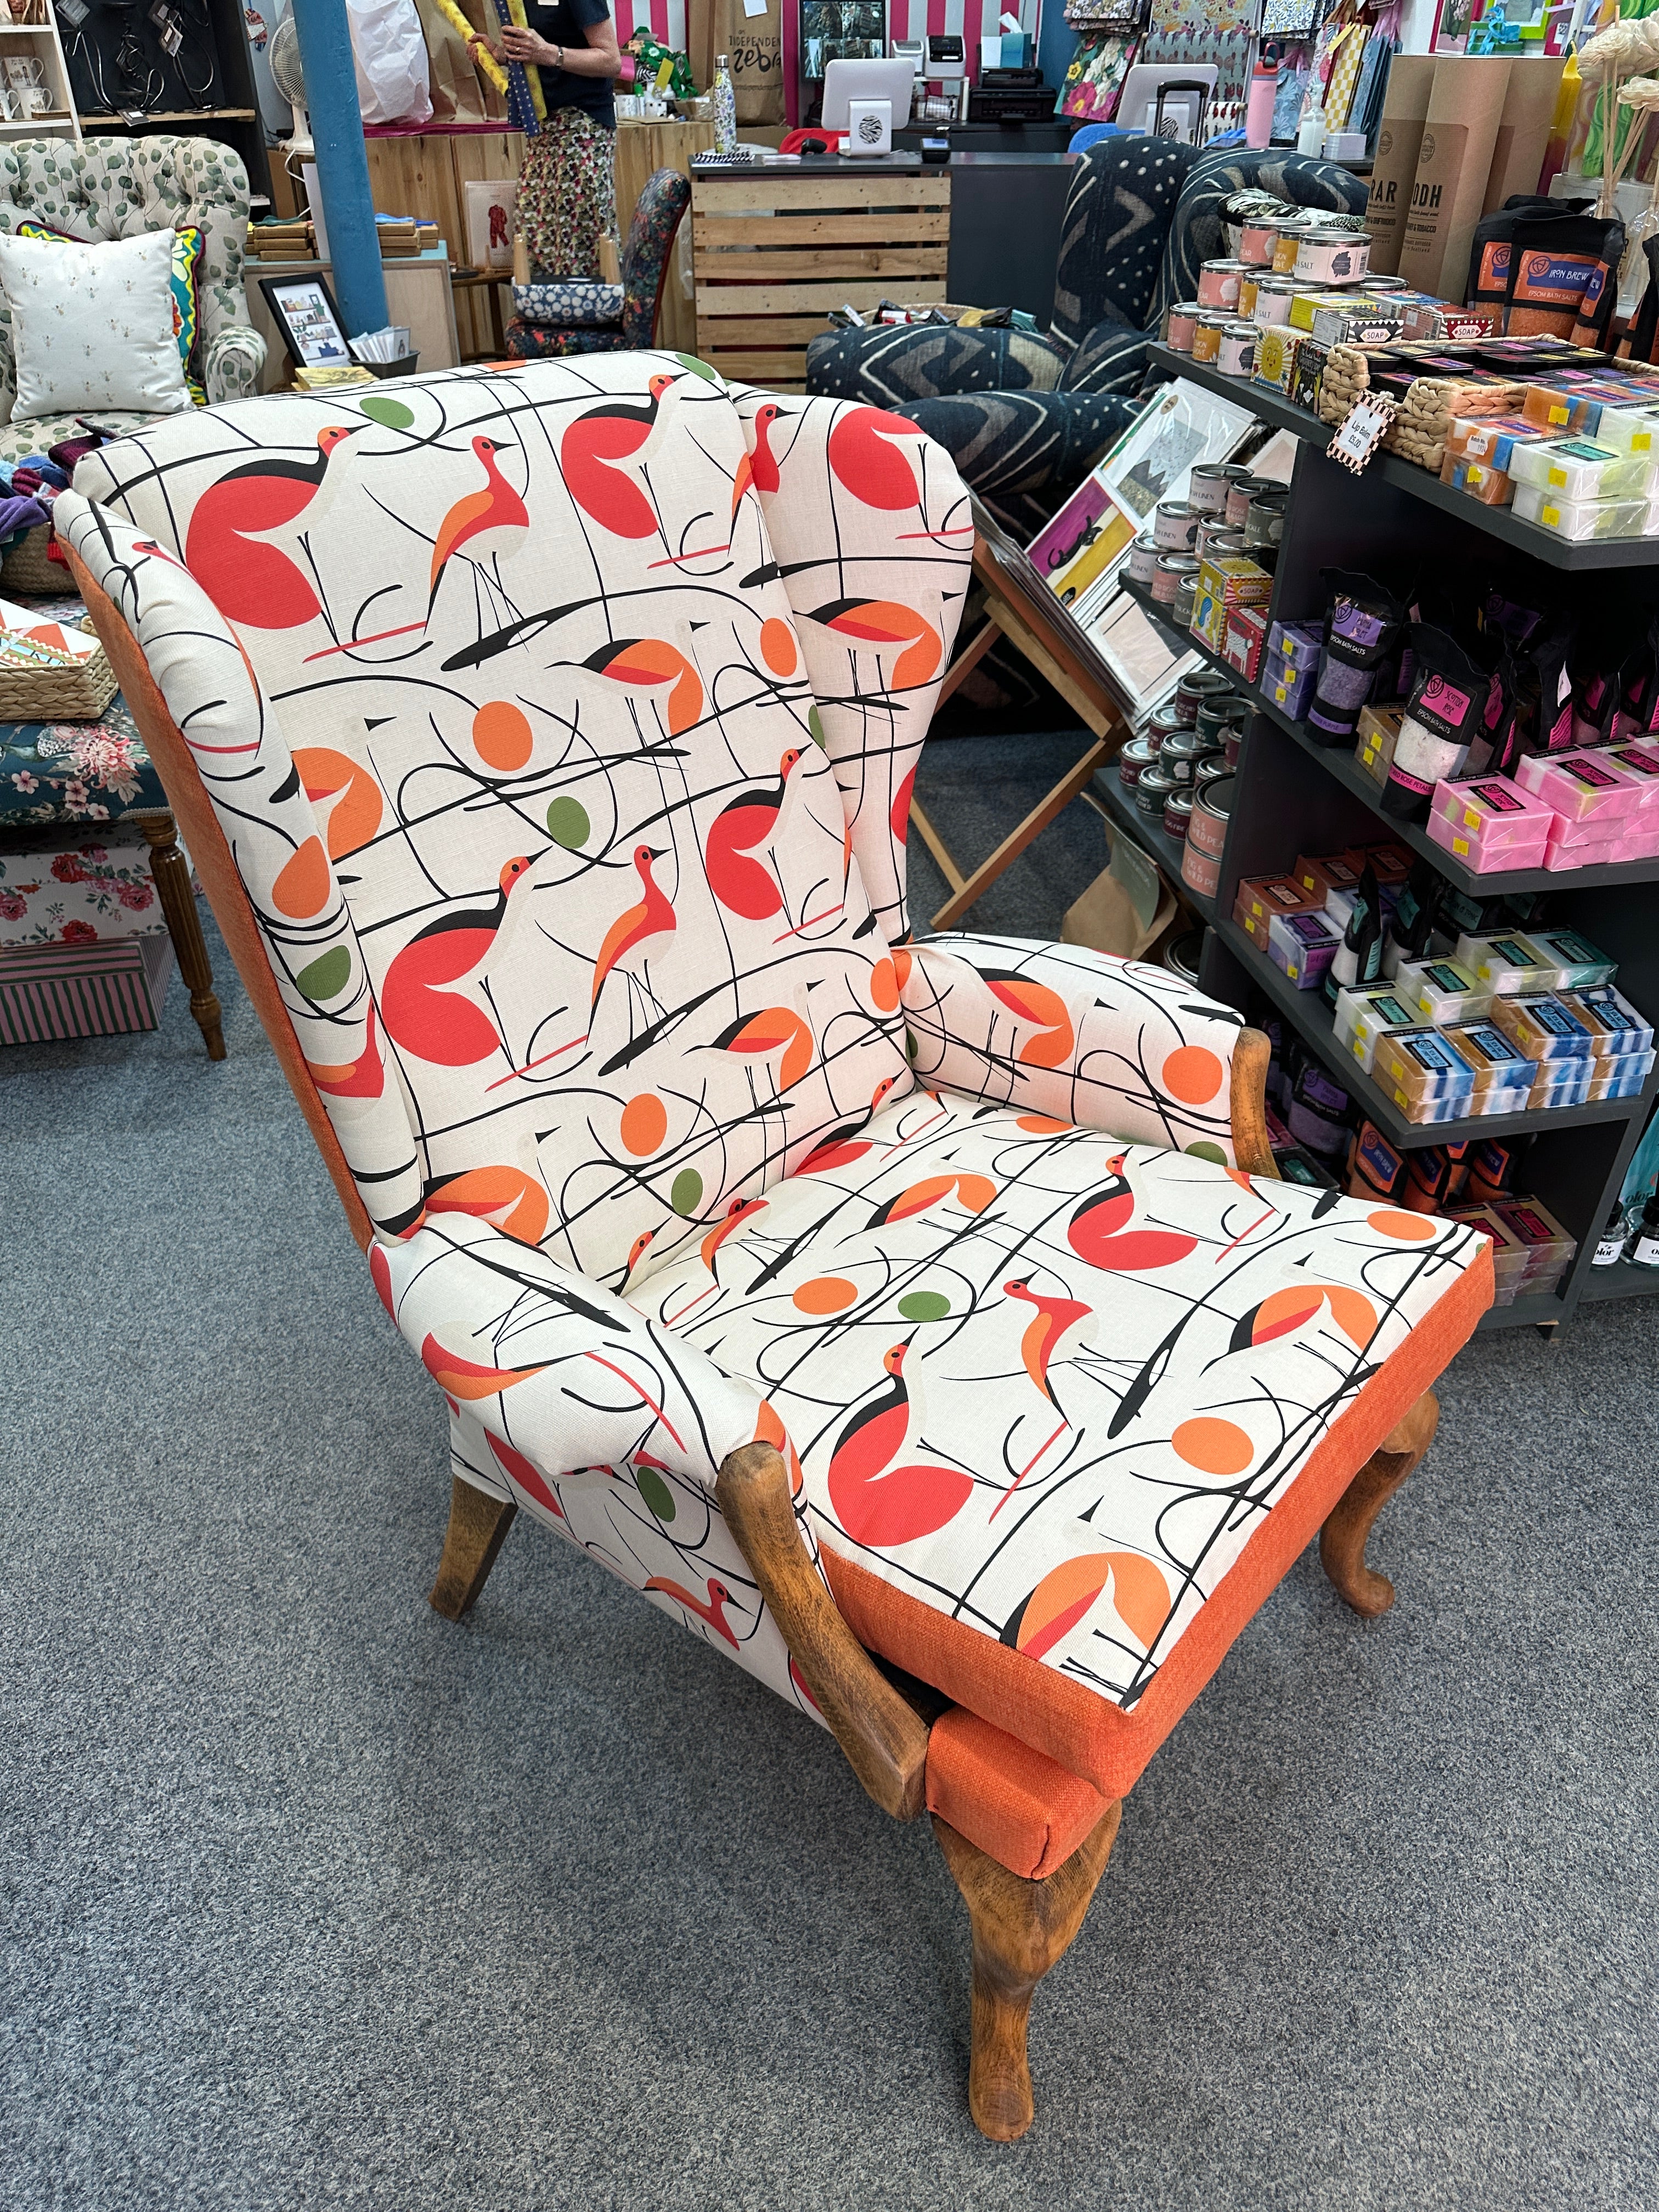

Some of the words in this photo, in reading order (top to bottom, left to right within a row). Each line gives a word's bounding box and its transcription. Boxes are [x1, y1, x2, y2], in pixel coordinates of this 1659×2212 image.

[1412, 183, 1442, 207] ODH
[1300, 261, 1314, 270] SALT
[1549, 269, 1566, 278] IRON
[1566, 270, 1590, 280] BREW
[1259, 310, 1271, 319] SALT
[1351, 420, 1361, 432] Lip
[1359, 426, 1370, 440] Balm
[1348, 435, 1361, 448] £5.00
[1198, 493, 1214, 501] LINEN
[1330, 634, 1342, 645] EPSOM
[1341, 640, 1352, 650] BATH
[1351, 645, 1366, 655] SALTS
[1417, 708, 1431, 722] EPSOM
[1430, 718, 1440, 729] BATH
[1438, 722, 1452, 735] SALTS
[1400, 774, 1413, 785] ROSE
[1413, 781, 1432, 792] PETALS
